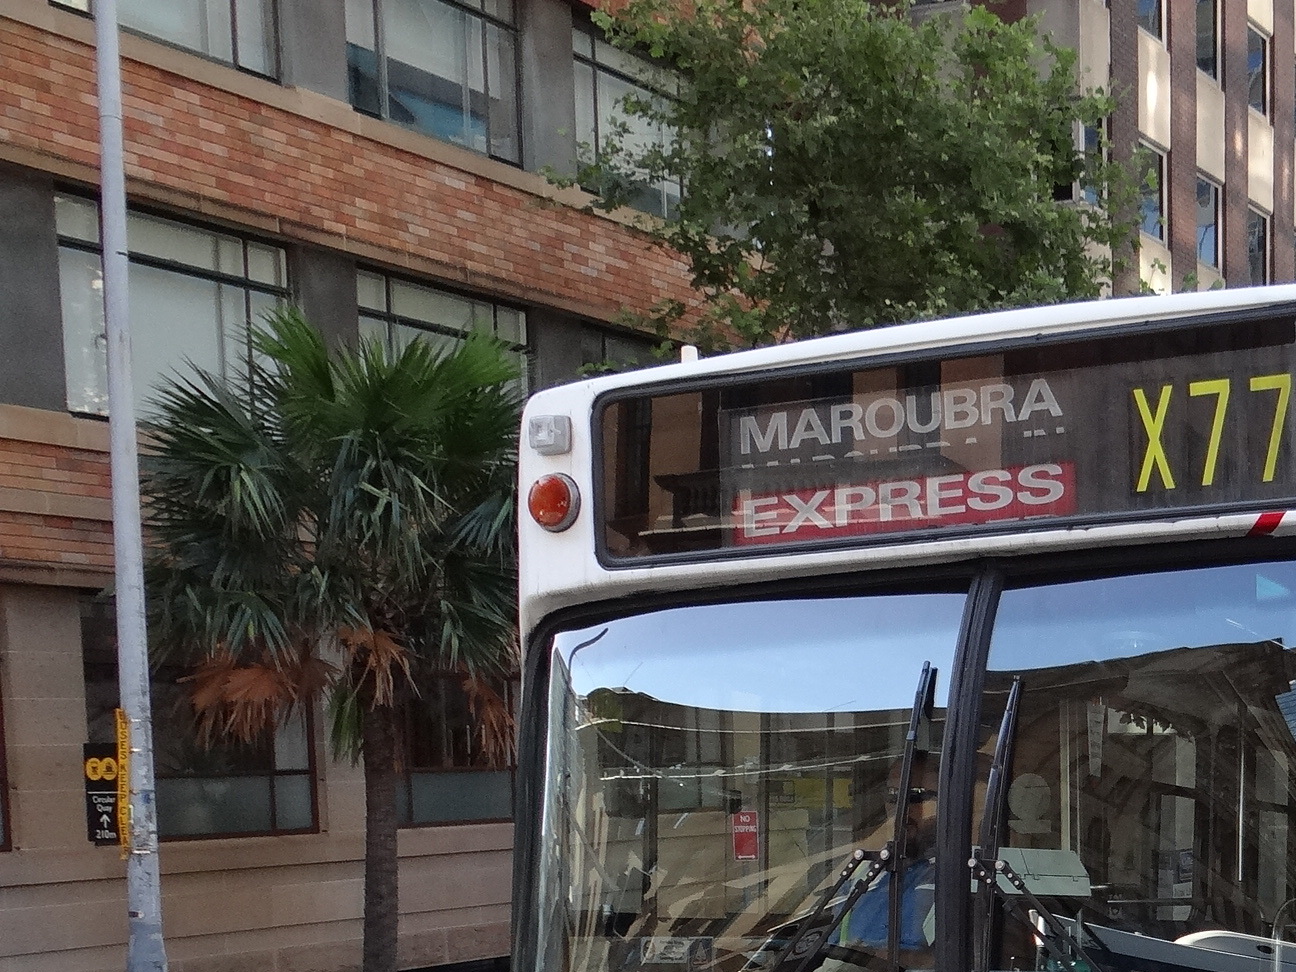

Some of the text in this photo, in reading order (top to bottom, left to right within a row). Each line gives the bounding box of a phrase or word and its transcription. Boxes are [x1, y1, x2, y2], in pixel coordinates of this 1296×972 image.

[739, 378, 1065, 456] MAROUBRA
[1133, 373, 1293, 494] X77
[742, 463, 1065, 538] EXPRESS
[119, 763, 128, 803] KEEP
[96, 804, 113, 813] Quay
[740, 815, 751, 823] NO
[95, 829, 117, 839] 210m
